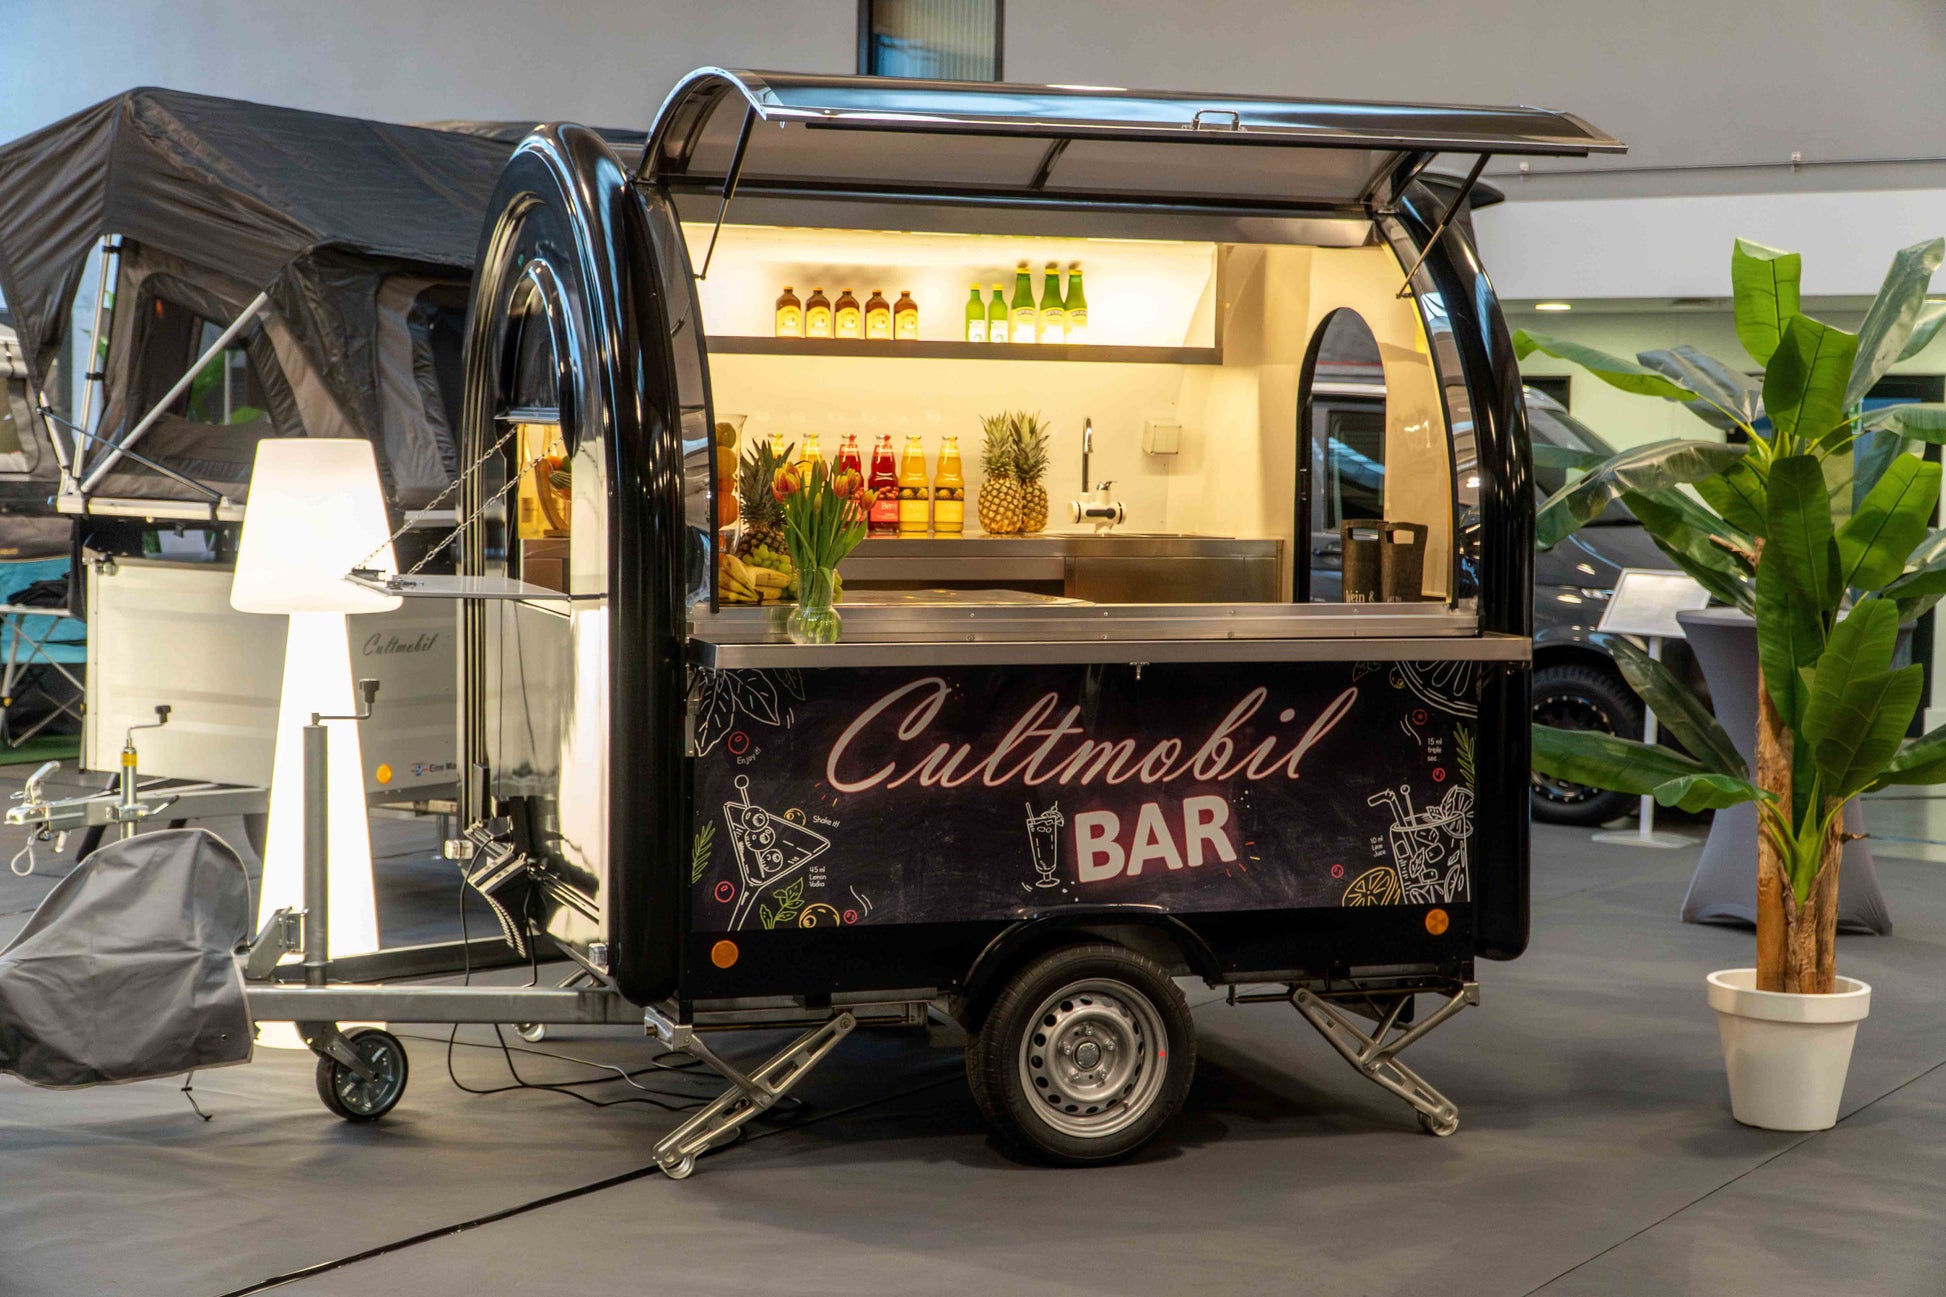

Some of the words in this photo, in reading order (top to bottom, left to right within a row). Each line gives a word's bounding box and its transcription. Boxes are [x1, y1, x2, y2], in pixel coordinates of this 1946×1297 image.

[363, 633, 439, 656] Cultmobil
[826, 677, 1358, 792] Cultmobil
[1427, 737, 1435, 745] 15
[736, 753, 756, 765] Enjoy
[812, 815, 832, 826] Shake
[1074, 795, 1238, 883] BAR
[1370, 836, 1377, 844] 10
[809, 873, 827, 881] Lemon
